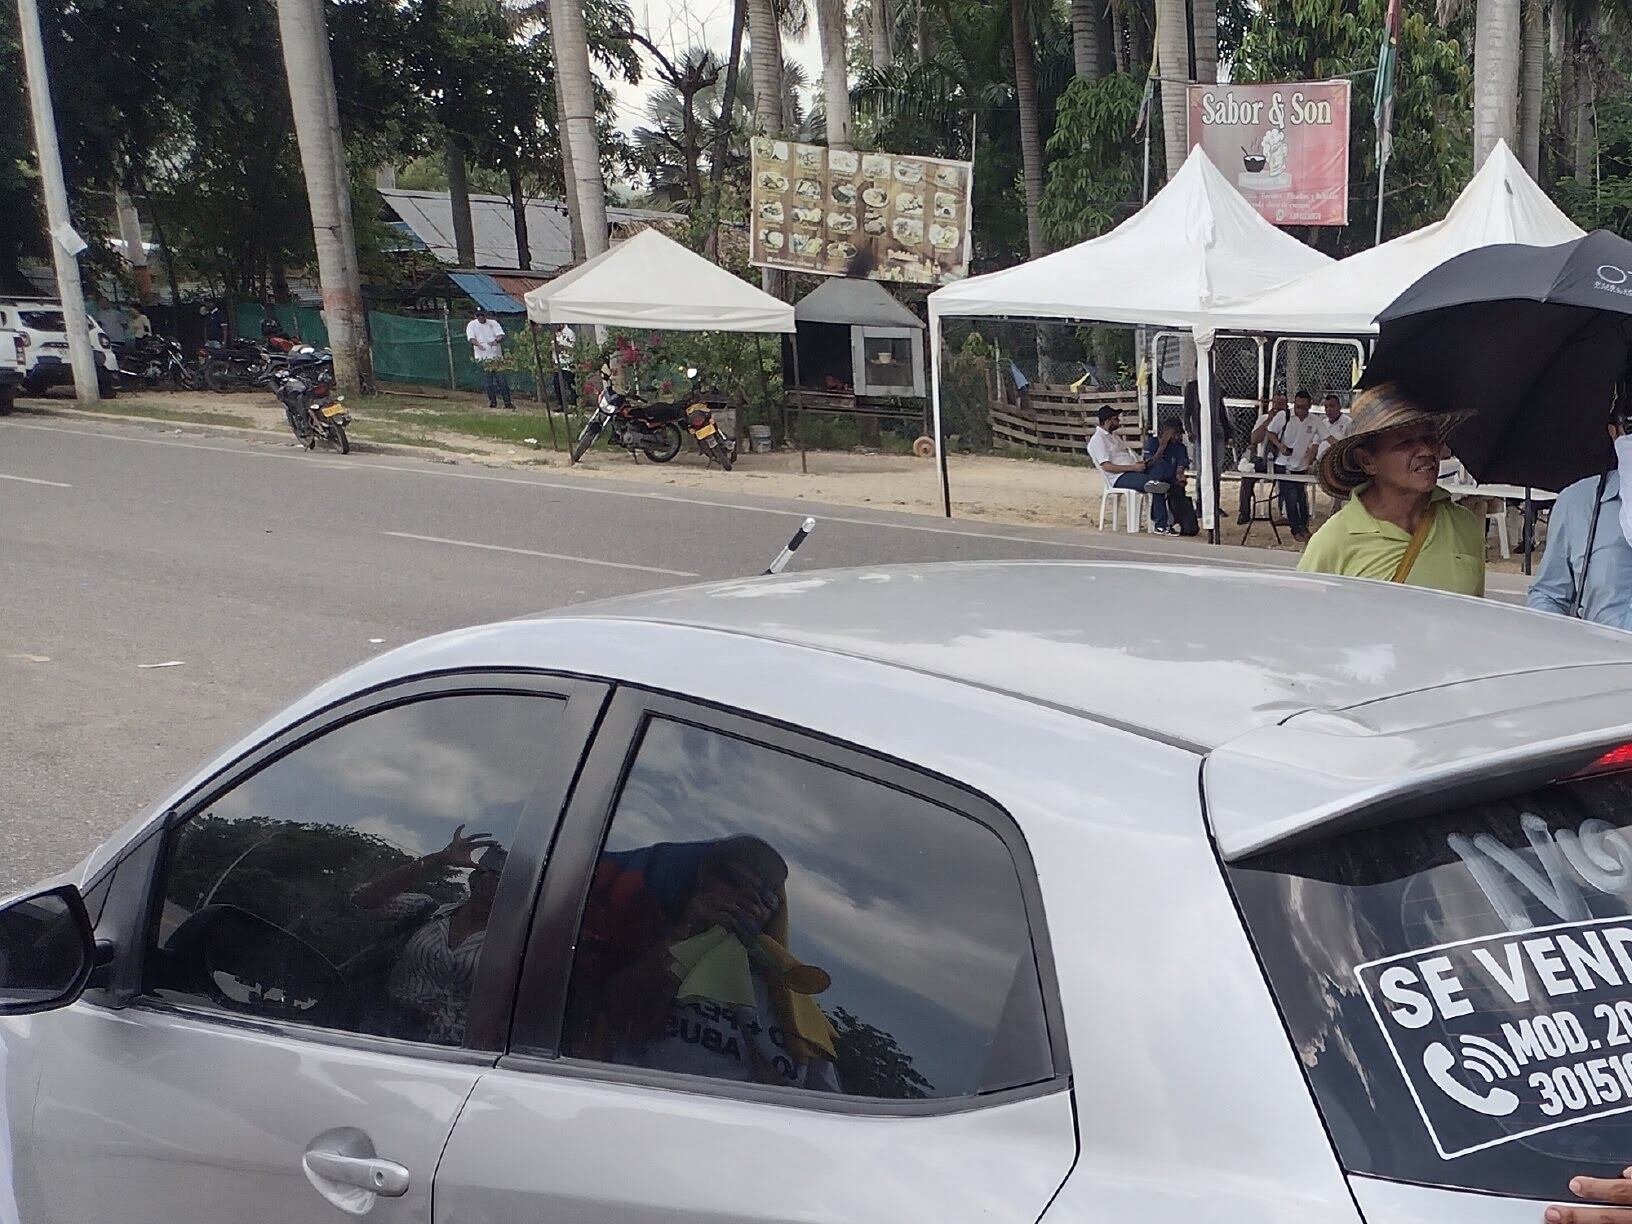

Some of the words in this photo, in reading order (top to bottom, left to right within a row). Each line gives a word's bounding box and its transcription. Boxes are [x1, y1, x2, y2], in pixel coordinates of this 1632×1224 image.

[1202, 92, 1263, 125] Sabor
[1268, 91, 1285, 129] &
[1290, 92, 1332, 125] Son
[1379, 956, 1474, 1029] SE
[1500, 1011, 1601, 1066] MOD.
